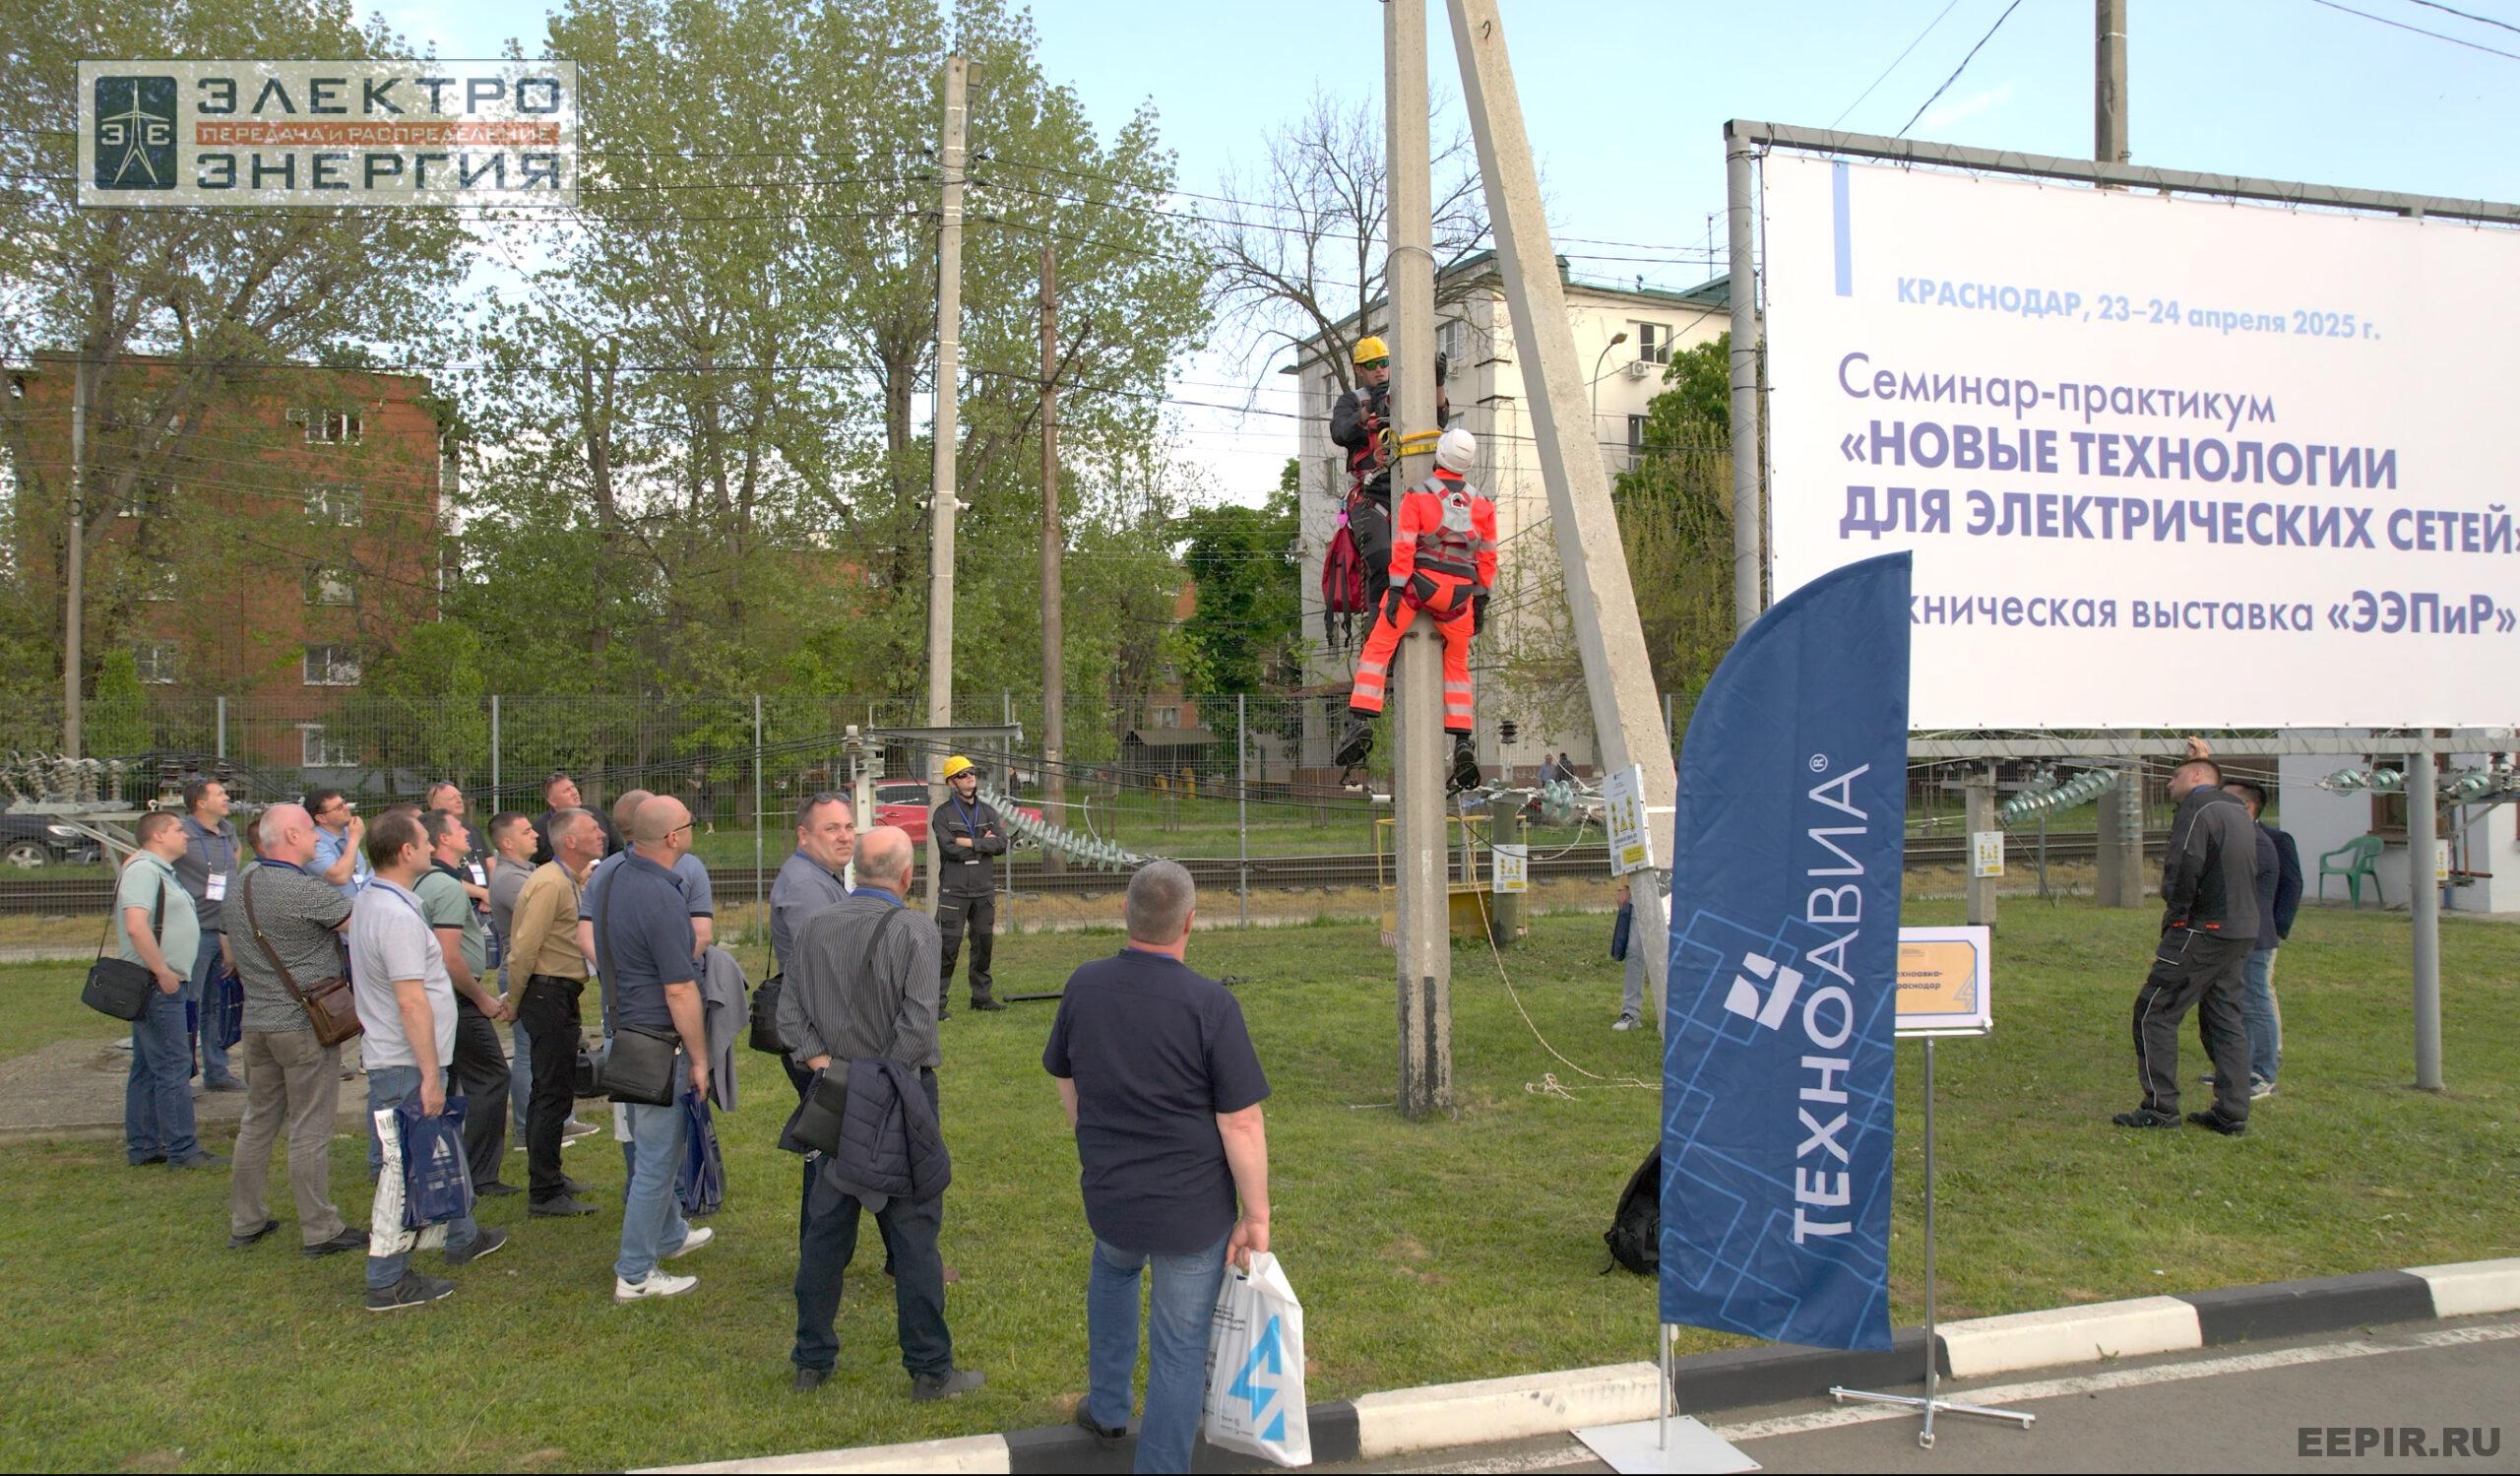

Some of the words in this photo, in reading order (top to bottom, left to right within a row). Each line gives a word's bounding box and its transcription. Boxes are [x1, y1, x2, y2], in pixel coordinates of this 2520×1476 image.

[1897, 277, 2090, 322] КРАСНОДАР,
[2187, 307, 2286, 336] апреля
[2293, 309, 2356, 339] 2025
[2362, 321, 2380, 341] г.
[1839, 352, 2276, 432] Семинар-практикум
[1840, 420, 2058, 474] «НОВЫЕ
[2070, 431, 2397, 489] ТЕХНОЛОГИИ
[1839, 485, 1951, 541] ДЛЯ
[1966, 489, 2375, 549] ЭЛЕКТРИЧЕСКИХ
[2132, 600, 2313, 631] выставка
[2327, 590, 2517, 634] «ЭЭПиР»
